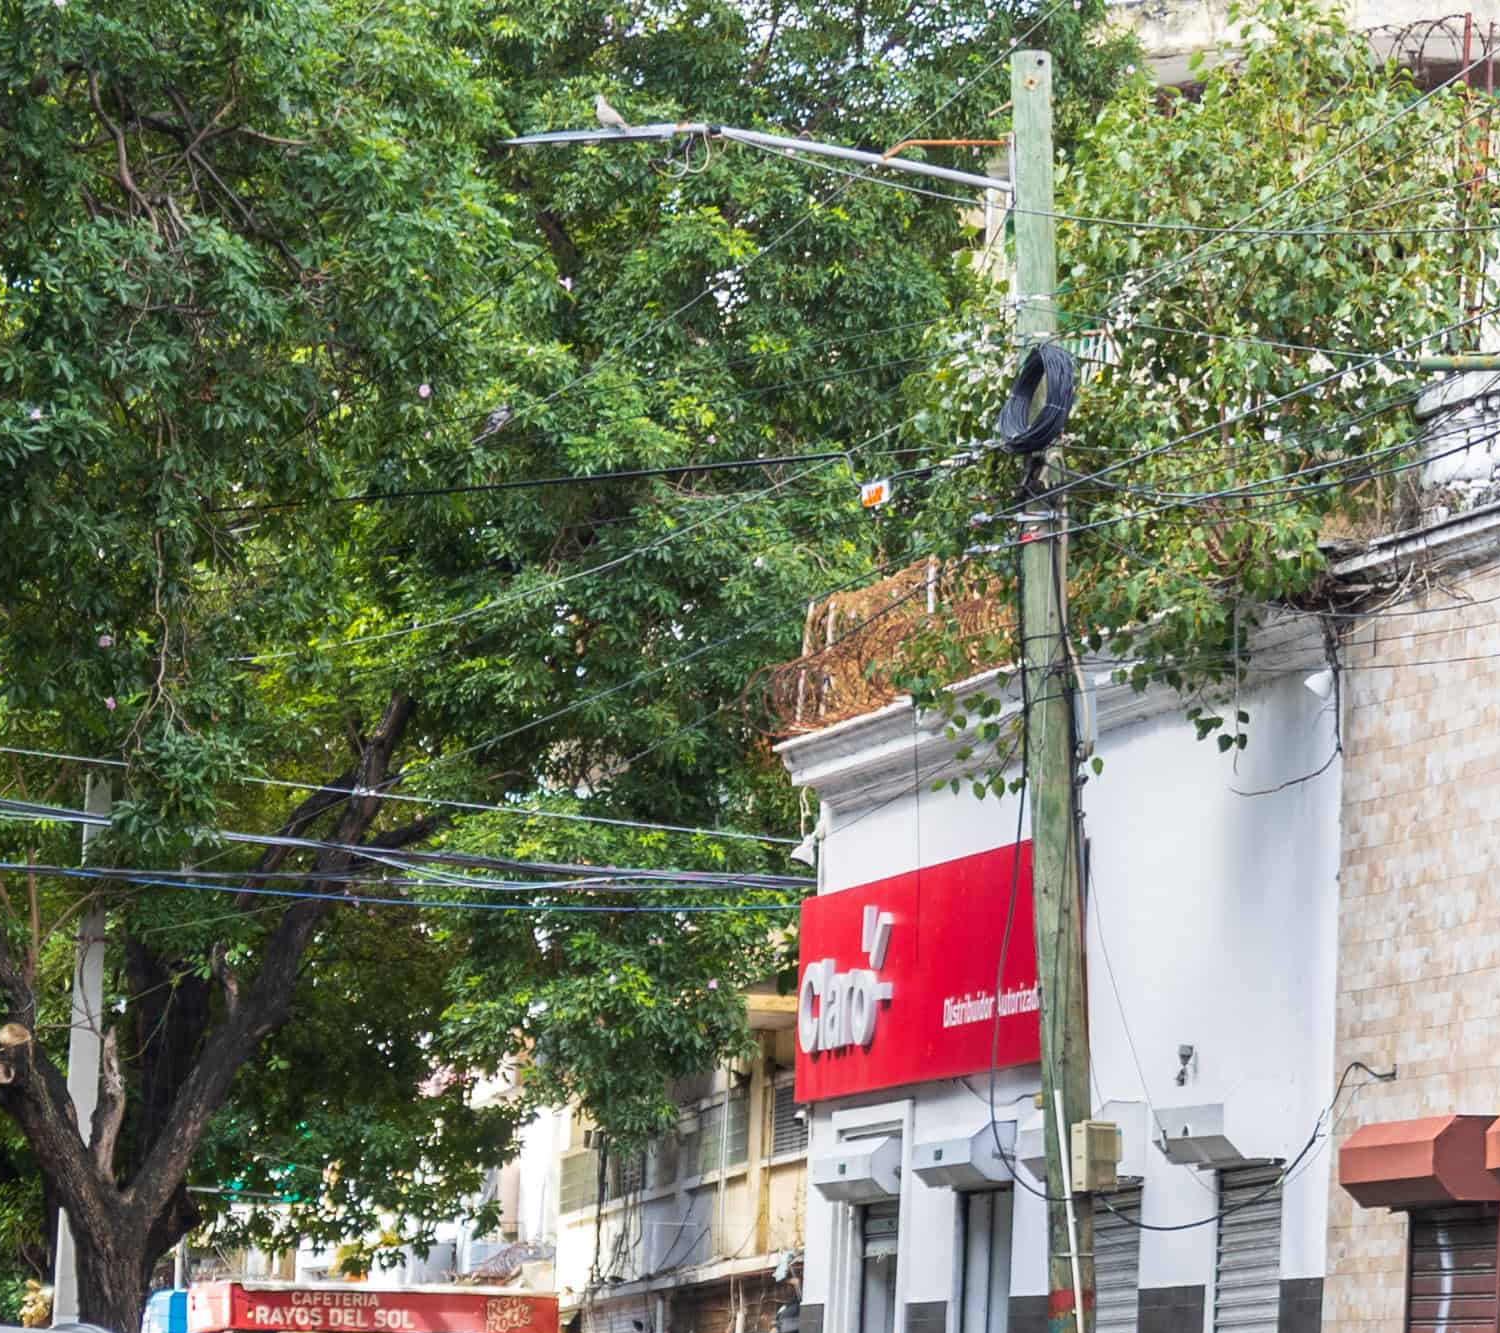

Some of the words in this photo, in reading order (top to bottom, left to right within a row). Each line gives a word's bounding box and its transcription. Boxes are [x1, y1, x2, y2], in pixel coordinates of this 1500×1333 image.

[799, 958, 878, 1054] Claro
[943, 991, 995, 1028] Distribuidor
[997, 980, 1040, 1017] Autorizad
[254, 1305, 323, 1327] RAYOS
[328, 1307, 369, 1328] DEL
[373, 1308, 415, 1329] SOL
[291, 1292, 380, 1307] CAFETERIA
